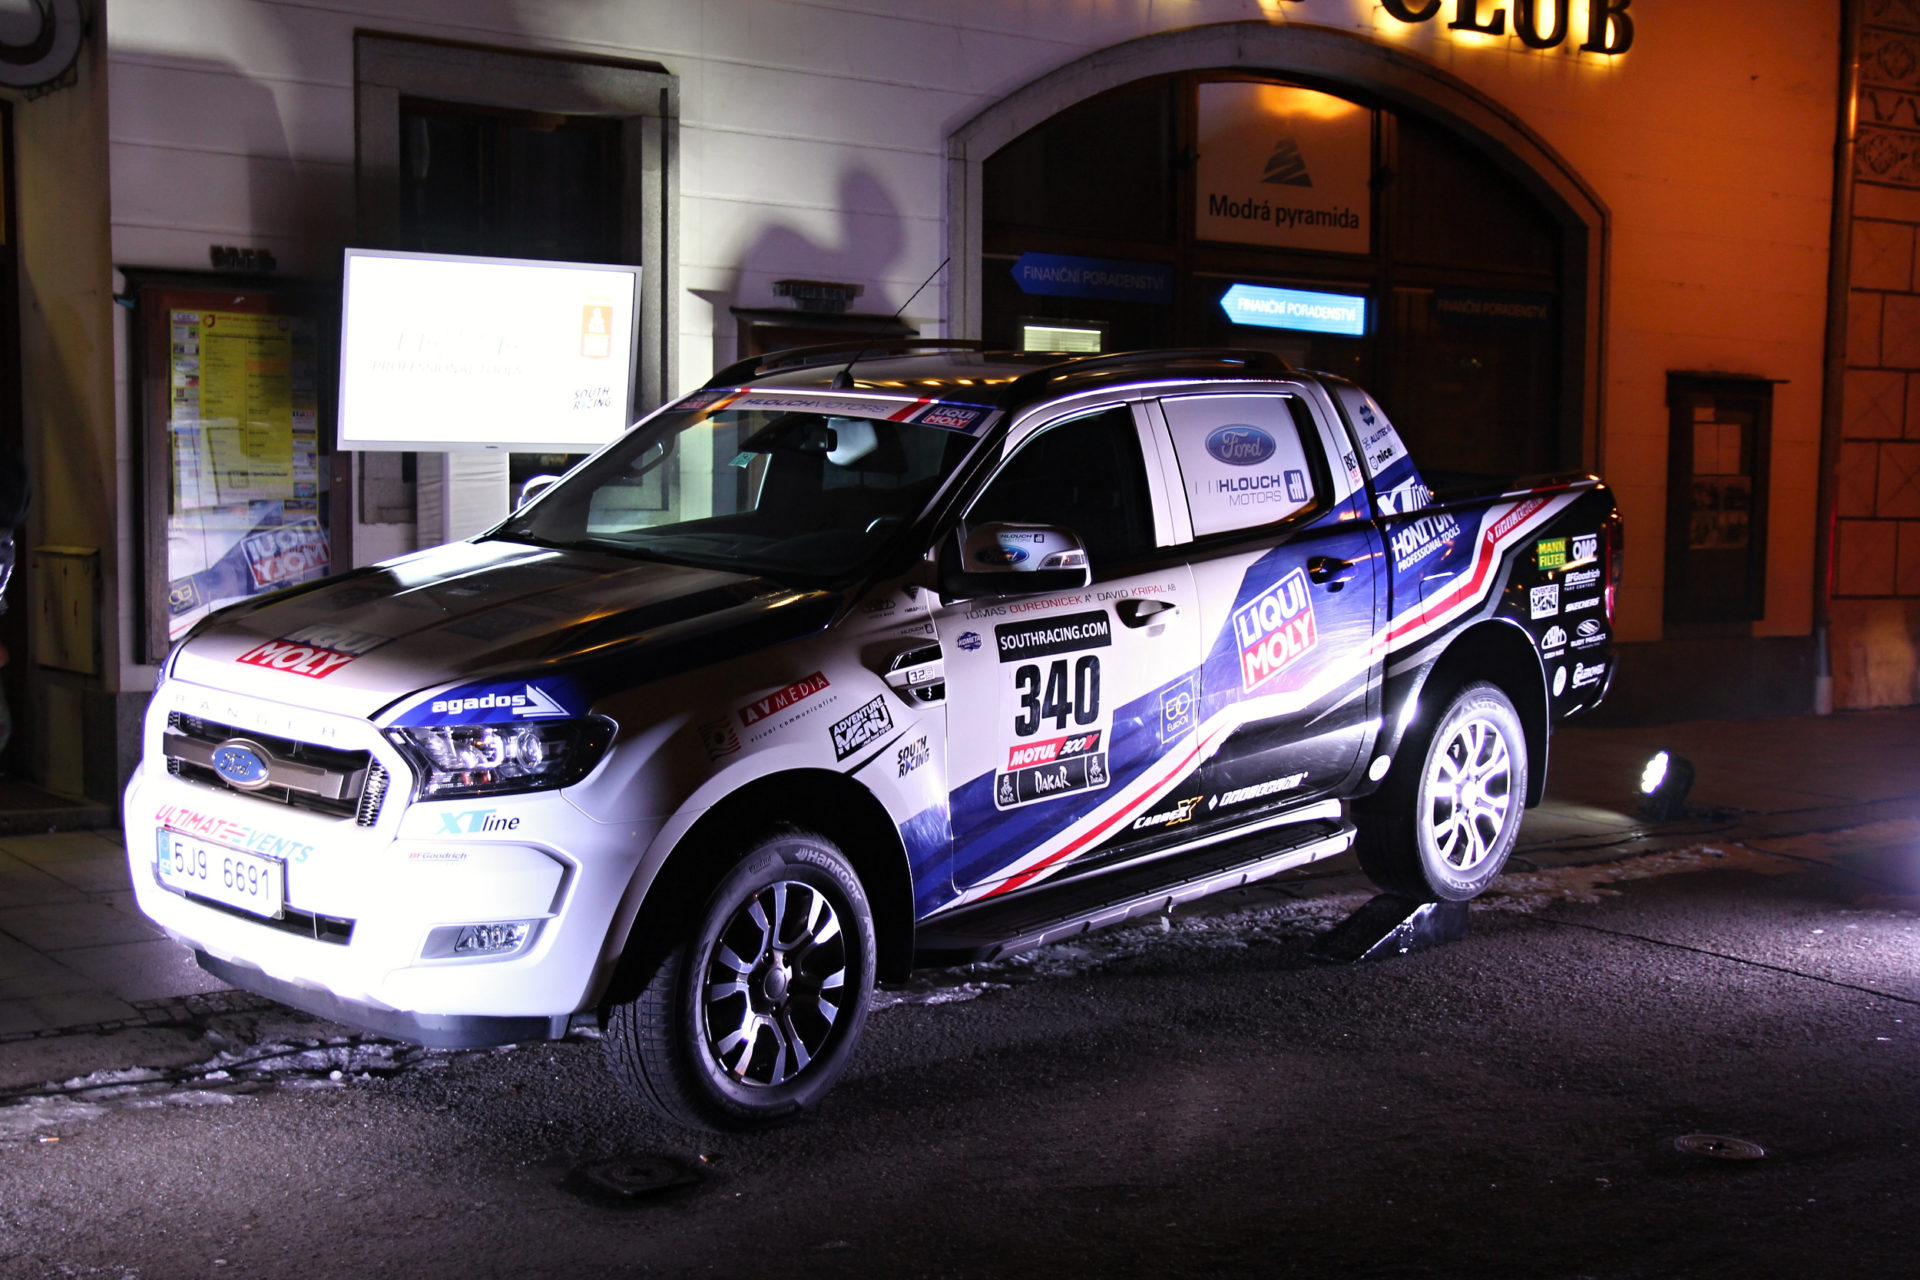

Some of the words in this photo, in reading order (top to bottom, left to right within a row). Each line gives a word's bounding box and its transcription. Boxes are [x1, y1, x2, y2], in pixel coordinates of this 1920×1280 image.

[1209, 193, 1271, 221] Modrá
[1275, 206, 1360, 230] pyramida
[1023, 264, 1081, 284] FINANČNÍ
[1083, 270, 1166, 291] PORADENSTVÍ
[1237, 297, 1286, 315] FINANČNÍ
[1286, 302, 1356, 321] PORADENSTVÍ
[573, 387, 611, 400] SOUTH
[927, 415, 969, 428] MOLY
[935, 407, 977, 419] LIQUI
[1220, 431, 1263, 459] Ford
[1219, 475, 1281, 493] HLOUCH
[1229, 490, 1282, 506] MOTORS
[1441, 524, 1461, 543] TOOLS
[1539, 540, 1566, 554] MANN
[1397, 538, 1443, 573] PROFESSIONAL
[1539, 552, 1566, 567] FILTER
[1572, 538, 1598, 560] OMP
[1565, 567, 1601, 583] BFGoodrich
[964, 606, 1007, 621] TOMAS
[1009, 595, 1084, 614] OUREDNICEK
[1097, 589, 1129, 602] DAVID
[1131, 585, 1167, 597] KRIPAL
[1238, 575, 1307, 648] LIQUI
[1000, 621, 1108, 650] SOUTHRACING.COM
[1245, 611, 1311, 686] MOLY
[241, 641, 354, 676] MOLY
[431, 693, 527, 715] agados
[1015, 655, 1101, 737] 340
[833, 695, 884, 735] ADVENTURE
[834, 705, 890, 756] MENU
[219, 750, 252, 777] Ford
[897, 735, 928, 765] SOUTH
[1010, 743, 1056, 767] MOTUL
[1059, 733, 1100, 755] 300V
[435, 807, 521, 836] XTline
[174, 841, 208, 881] 5J9
[223, 857, 271, 901] 6691
